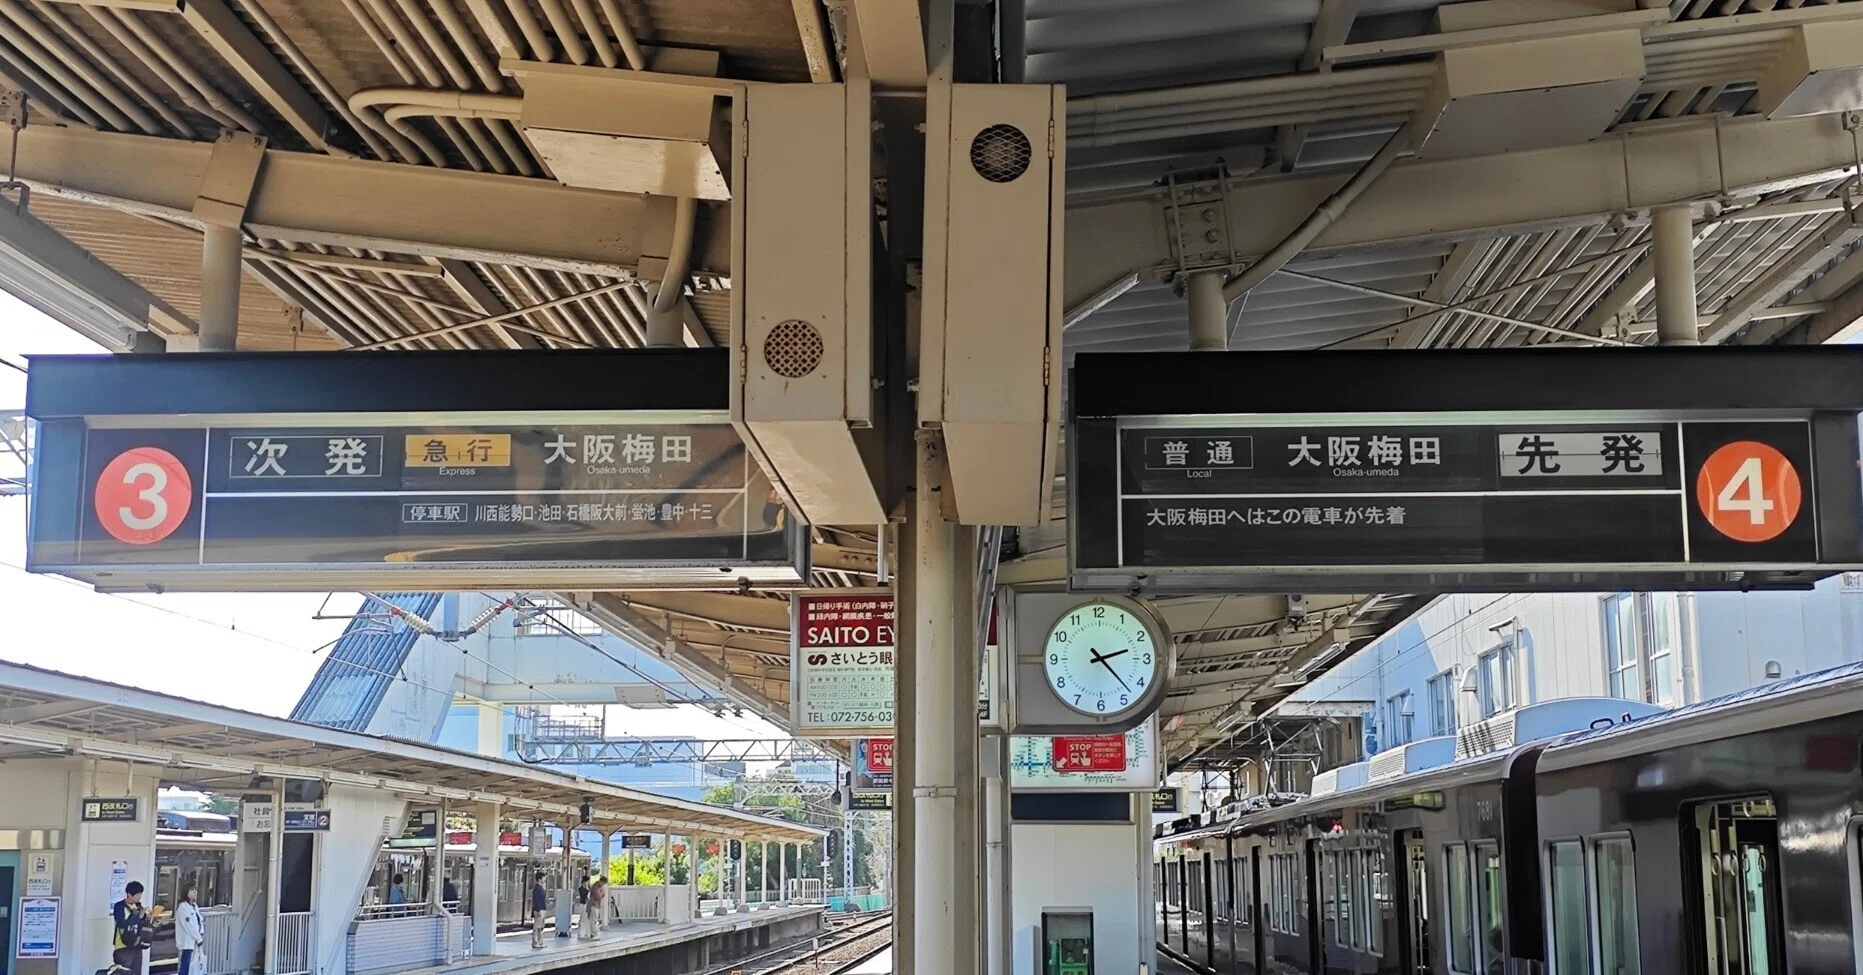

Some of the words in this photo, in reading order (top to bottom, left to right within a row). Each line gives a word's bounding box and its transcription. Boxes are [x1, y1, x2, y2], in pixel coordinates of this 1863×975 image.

[422, 438, 493, 463] 急行
[543, 434, 692, 465] 大阪梅田
[1162, 440, 1235, 466] 普通
[1286, 435, 1441, 467] 大阪梅田
[439, 467, 476, 476] Express
[587, 465, 651, 475] Osaka-umeda
[1187, 469, 1212, 478] Local
[1333, 468, 1400, 478] Osaka-umeda
[118, 462, 168, 530] 3
[1717, 457, 1774, 525] 4
[410, 505, 461, 522] 停車駅
[1146, 506, 1407, 527] 大阪梅田へはこの電車が先着
[1093, 607, 1105, 618] 12
[1070, 615, 1081, 625] 11
[1119, 614, 1125, 625] 1
[808, 626, 870, 644] SAITO
[1055, 631, 1067, 643] 10
[1136, 631, 1145, 642] 2
[831, 651, 893, 665] さいとう眼
[1050, 653, 1058, 665] 9
[1142, 653, 1151, 664] 3
[1057, 677, 1065, 688] 8
[1136, 677, 1145, 687] 4
[1074, 695, 1081, 706] 7
[1120, 694, 1128, 705] 5
[1097, 700, 1105, 711] 6
[1069, 743, 1091, 751] STOP
[319, 815, 328, 826] 2
